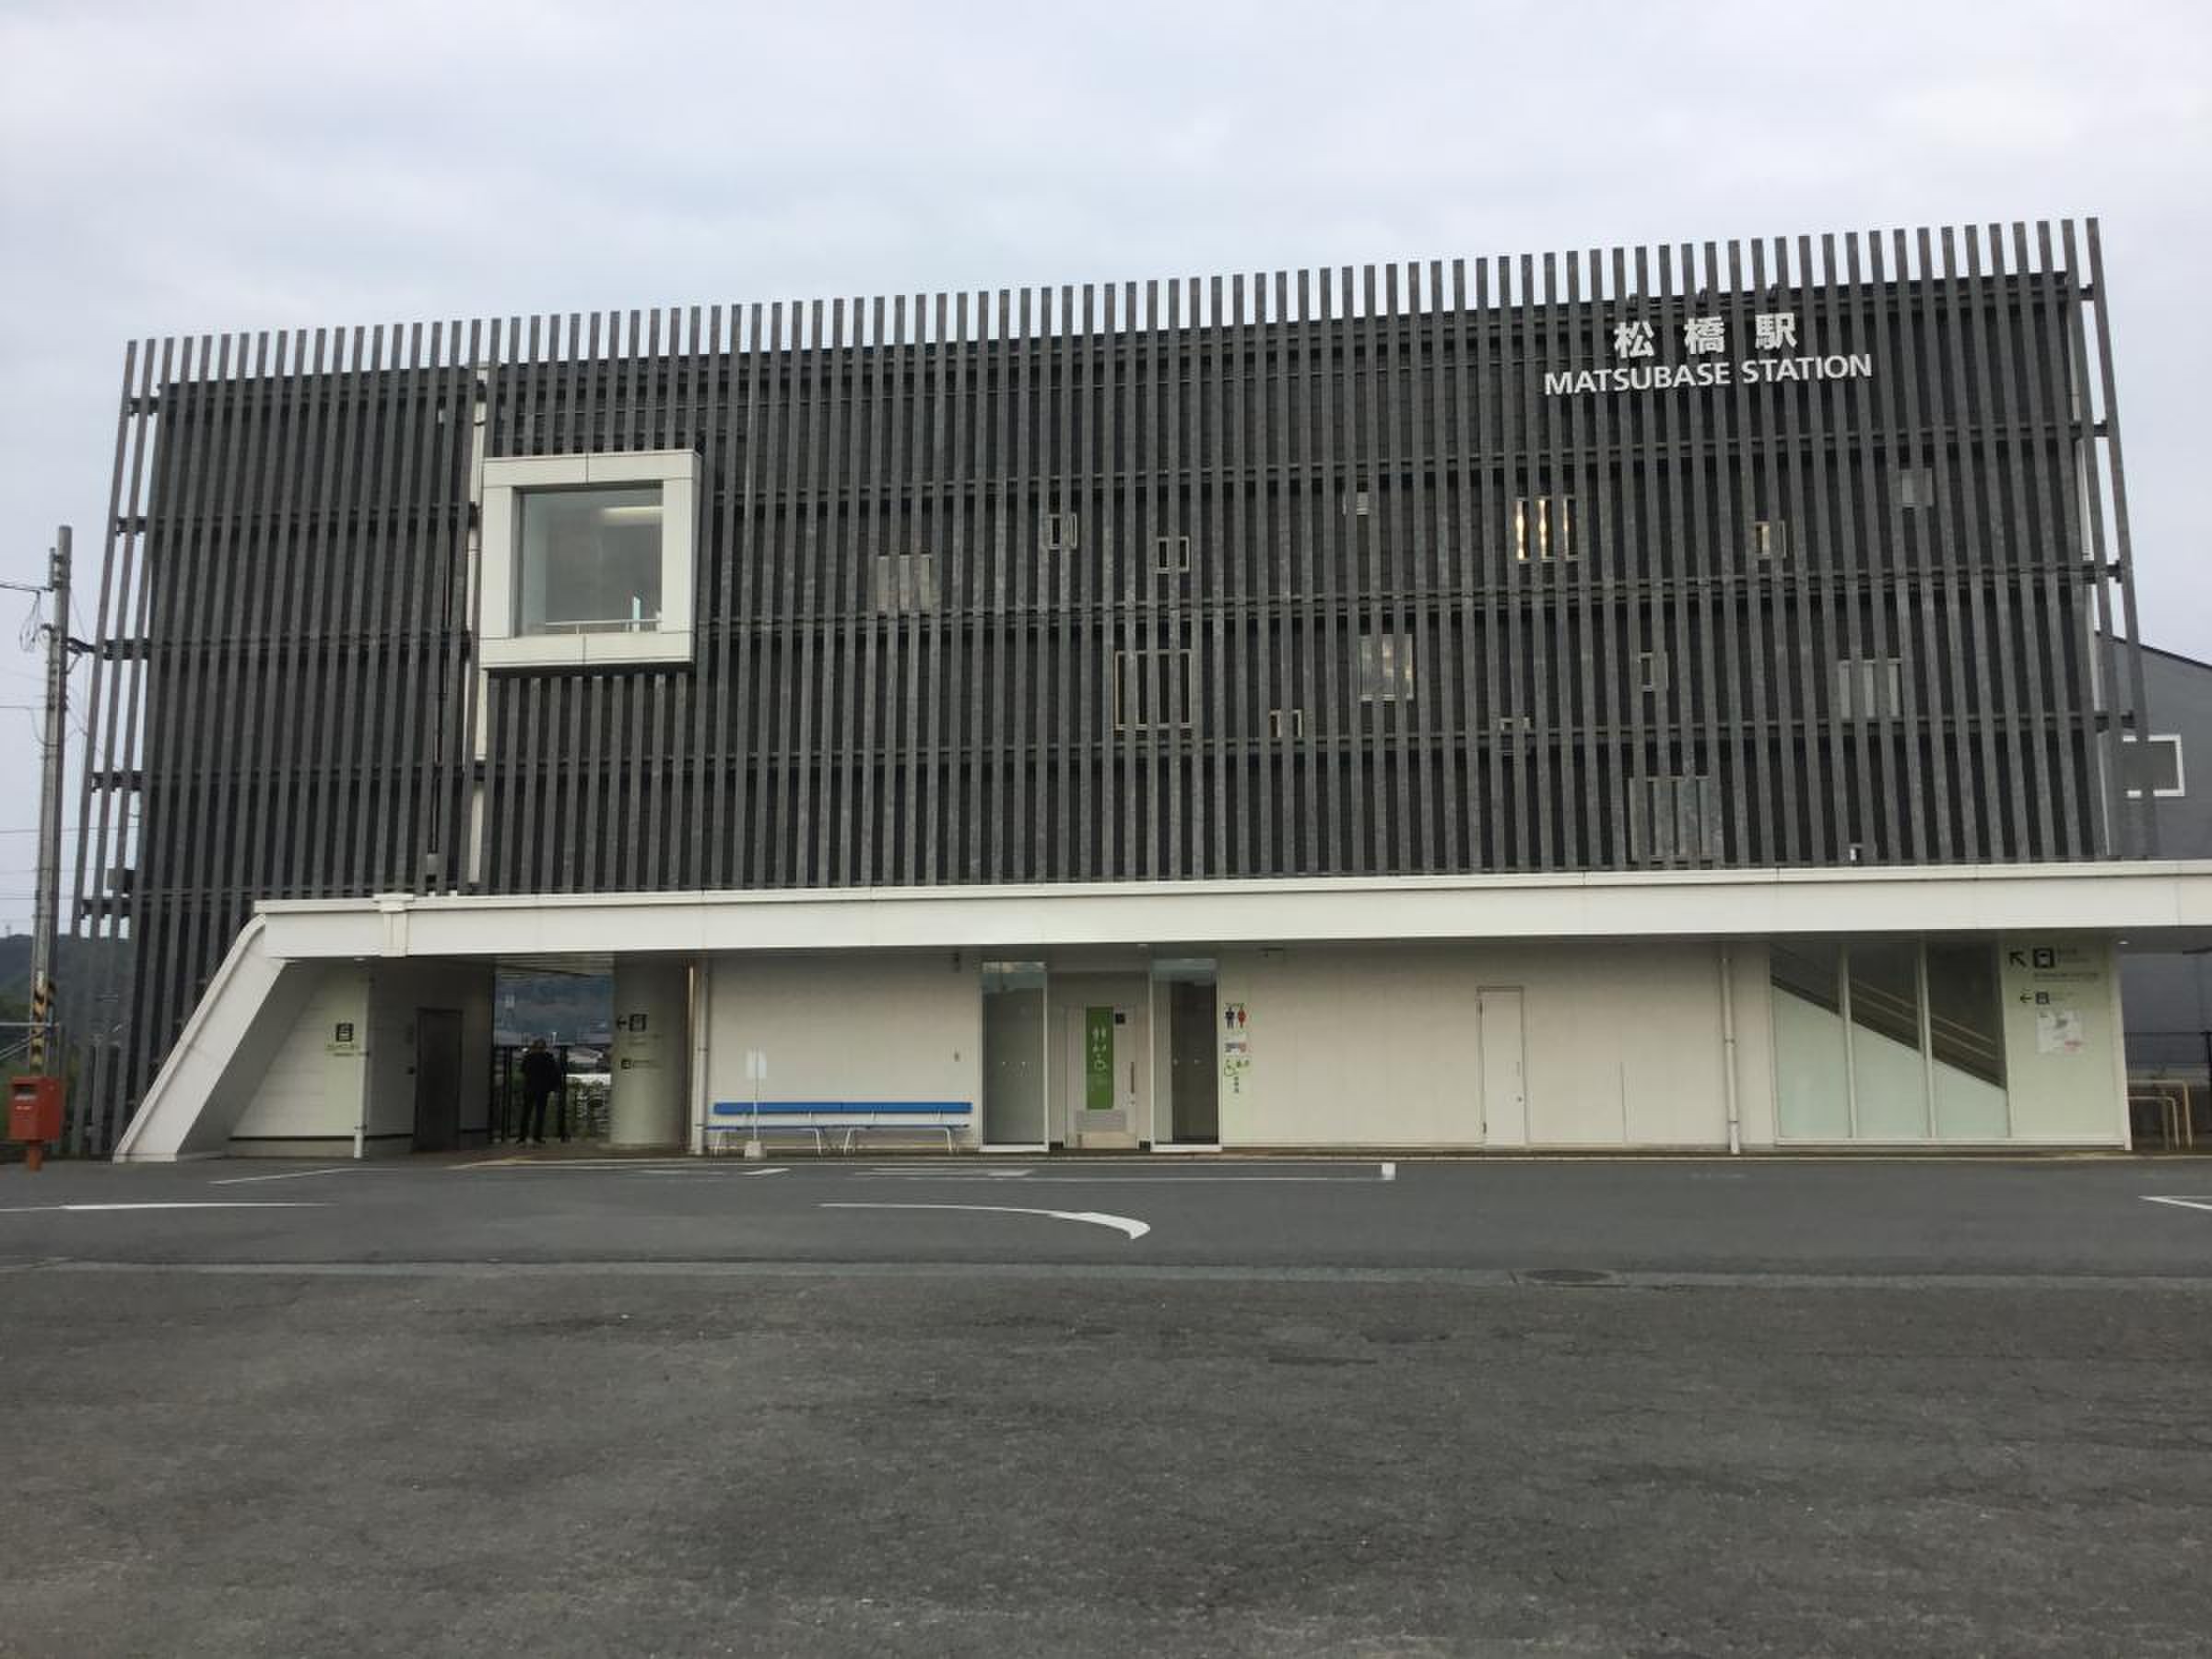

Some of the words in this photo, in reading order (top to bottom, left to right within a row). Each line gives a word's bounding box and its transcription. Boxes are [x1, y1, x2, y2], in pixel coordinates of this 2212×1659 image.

[1614, 312, 1798, 359] 松橋駅
[1544, 361, 1731, 396] MATSUBASE
[1742, 353, 1873, 384] STATION
